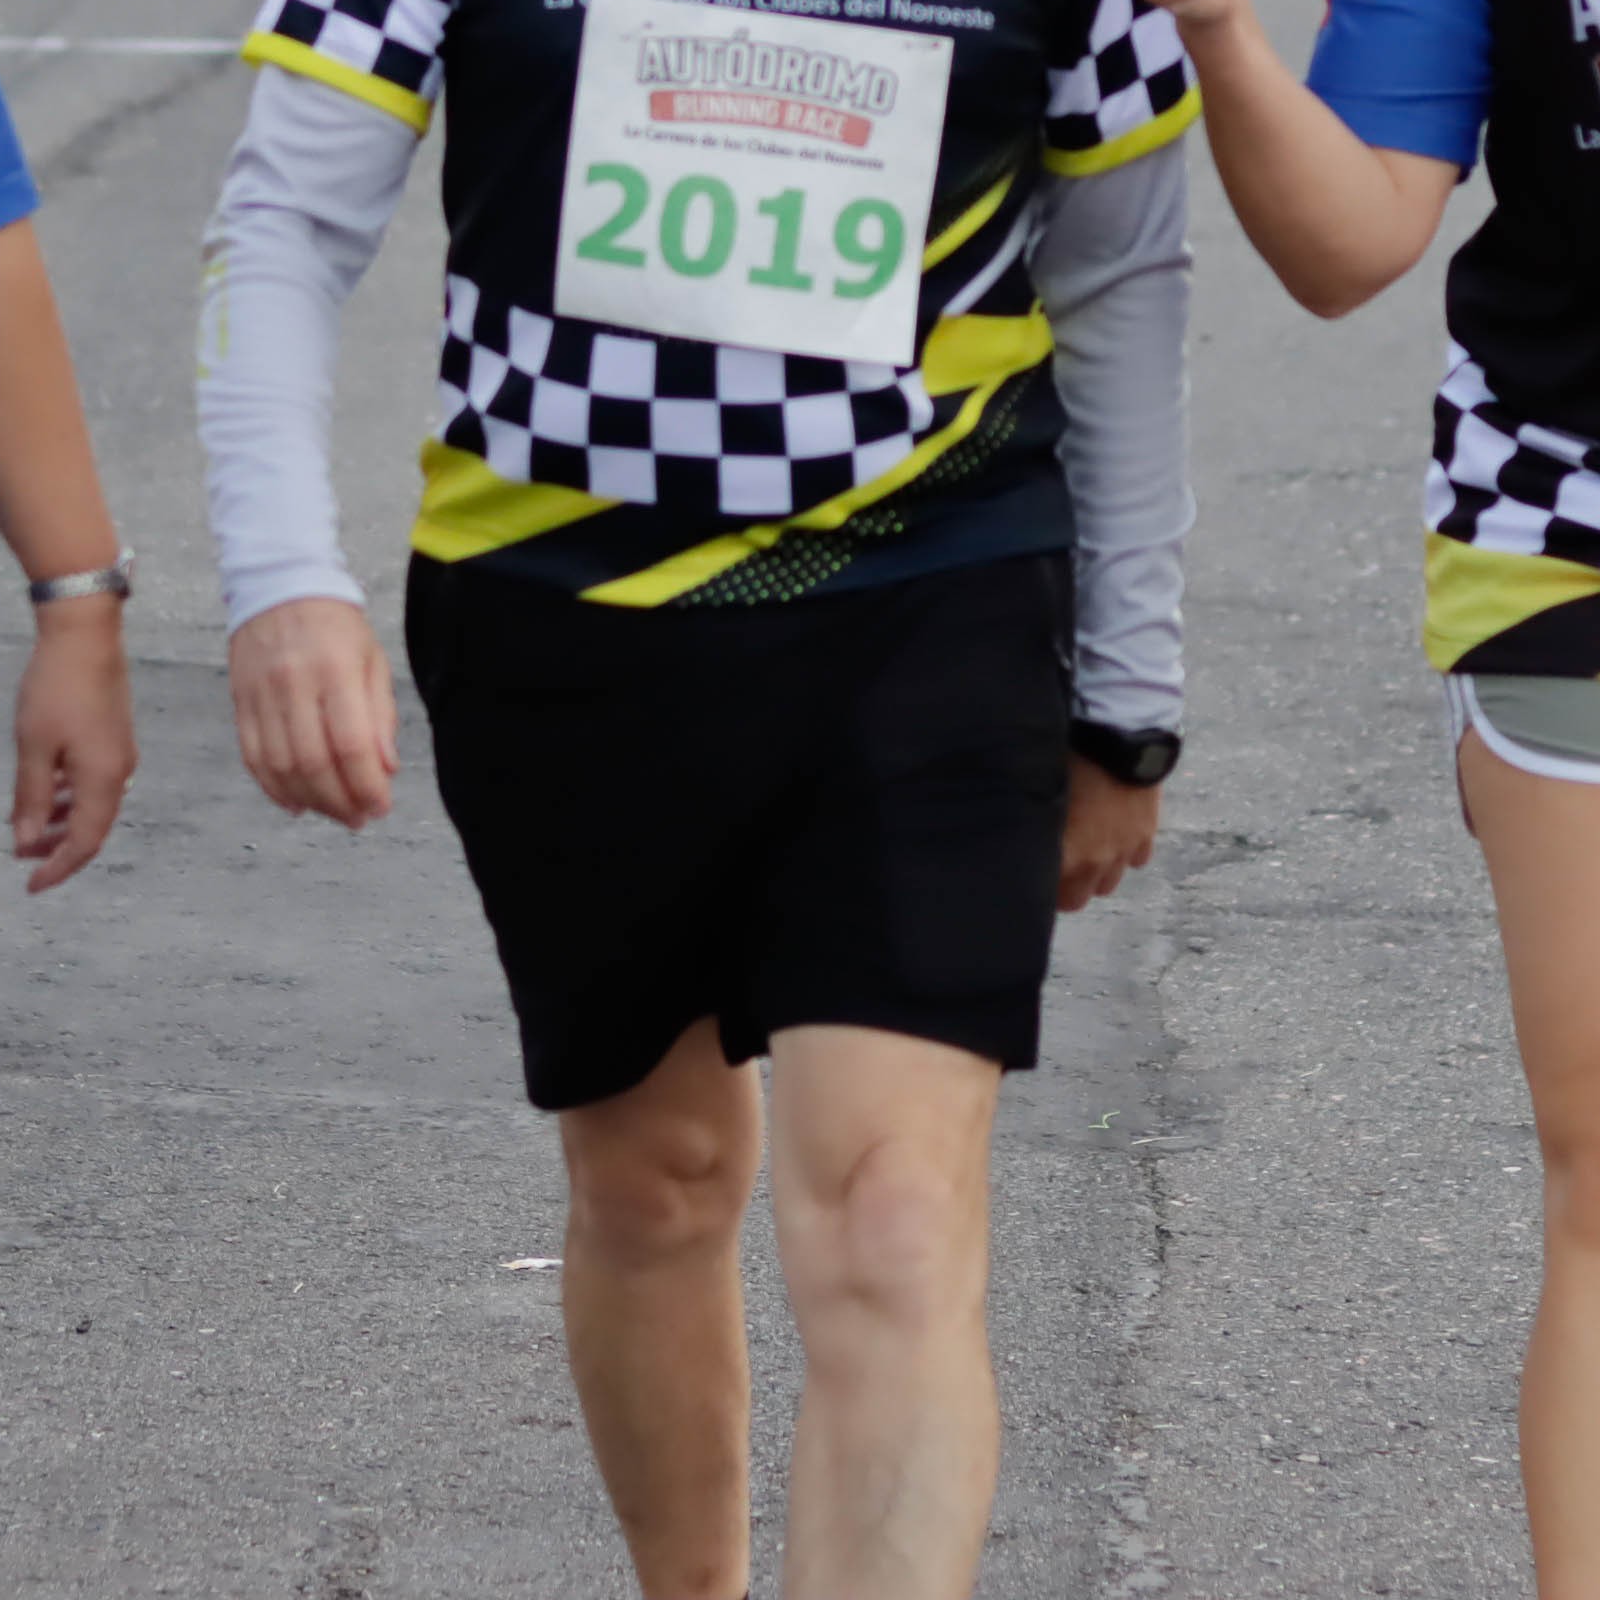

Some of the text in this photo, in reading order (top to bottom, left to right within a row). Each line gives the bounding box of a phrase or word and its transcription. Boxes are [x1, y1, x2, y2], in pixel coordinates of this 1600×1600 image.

[636, 28, 899, 116] AUTÓDROMO
[673, 92, 847, 138] RUNNING RACE
[576, 163, 907, 301] 2019
